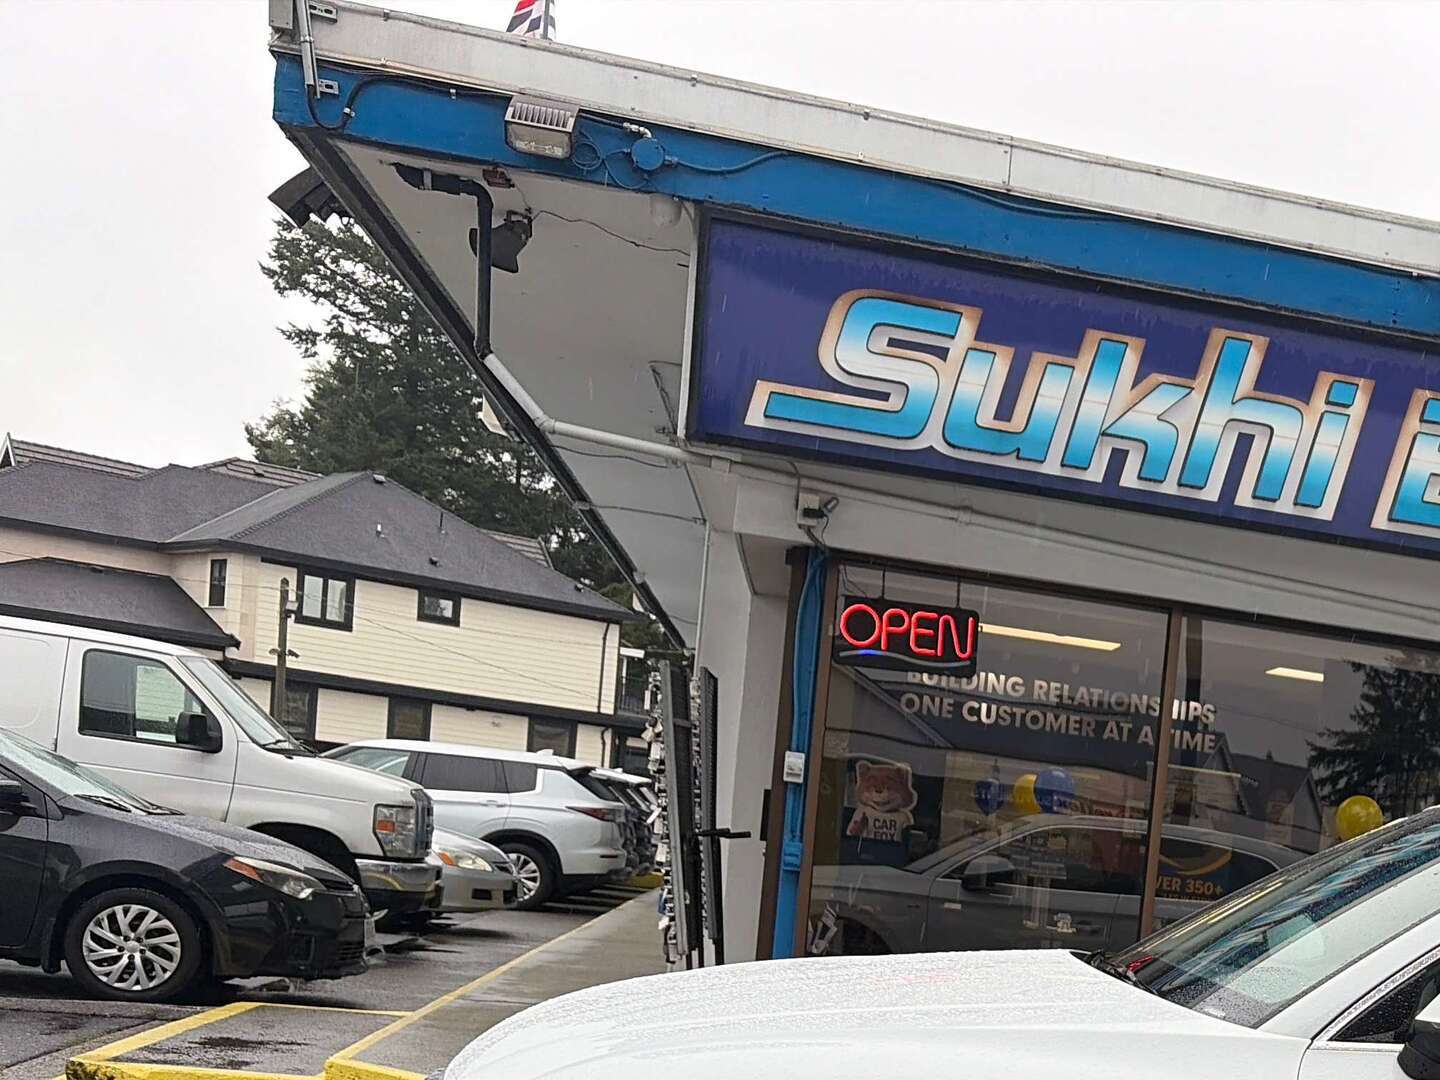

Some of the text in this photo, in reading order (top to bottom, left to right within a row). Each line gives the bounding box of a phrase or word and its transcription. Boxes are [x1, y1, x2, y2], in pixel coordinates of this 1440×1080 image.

[744, 288, 1374, 521] Sukhi
[839, 603, 976, 660] OPEN
[901, 693, 1217, 754] ONE CUSTOMER AT A IME
[873, 818, 897, 832] CAR
[1184, 879, 1224, 896] 350+
